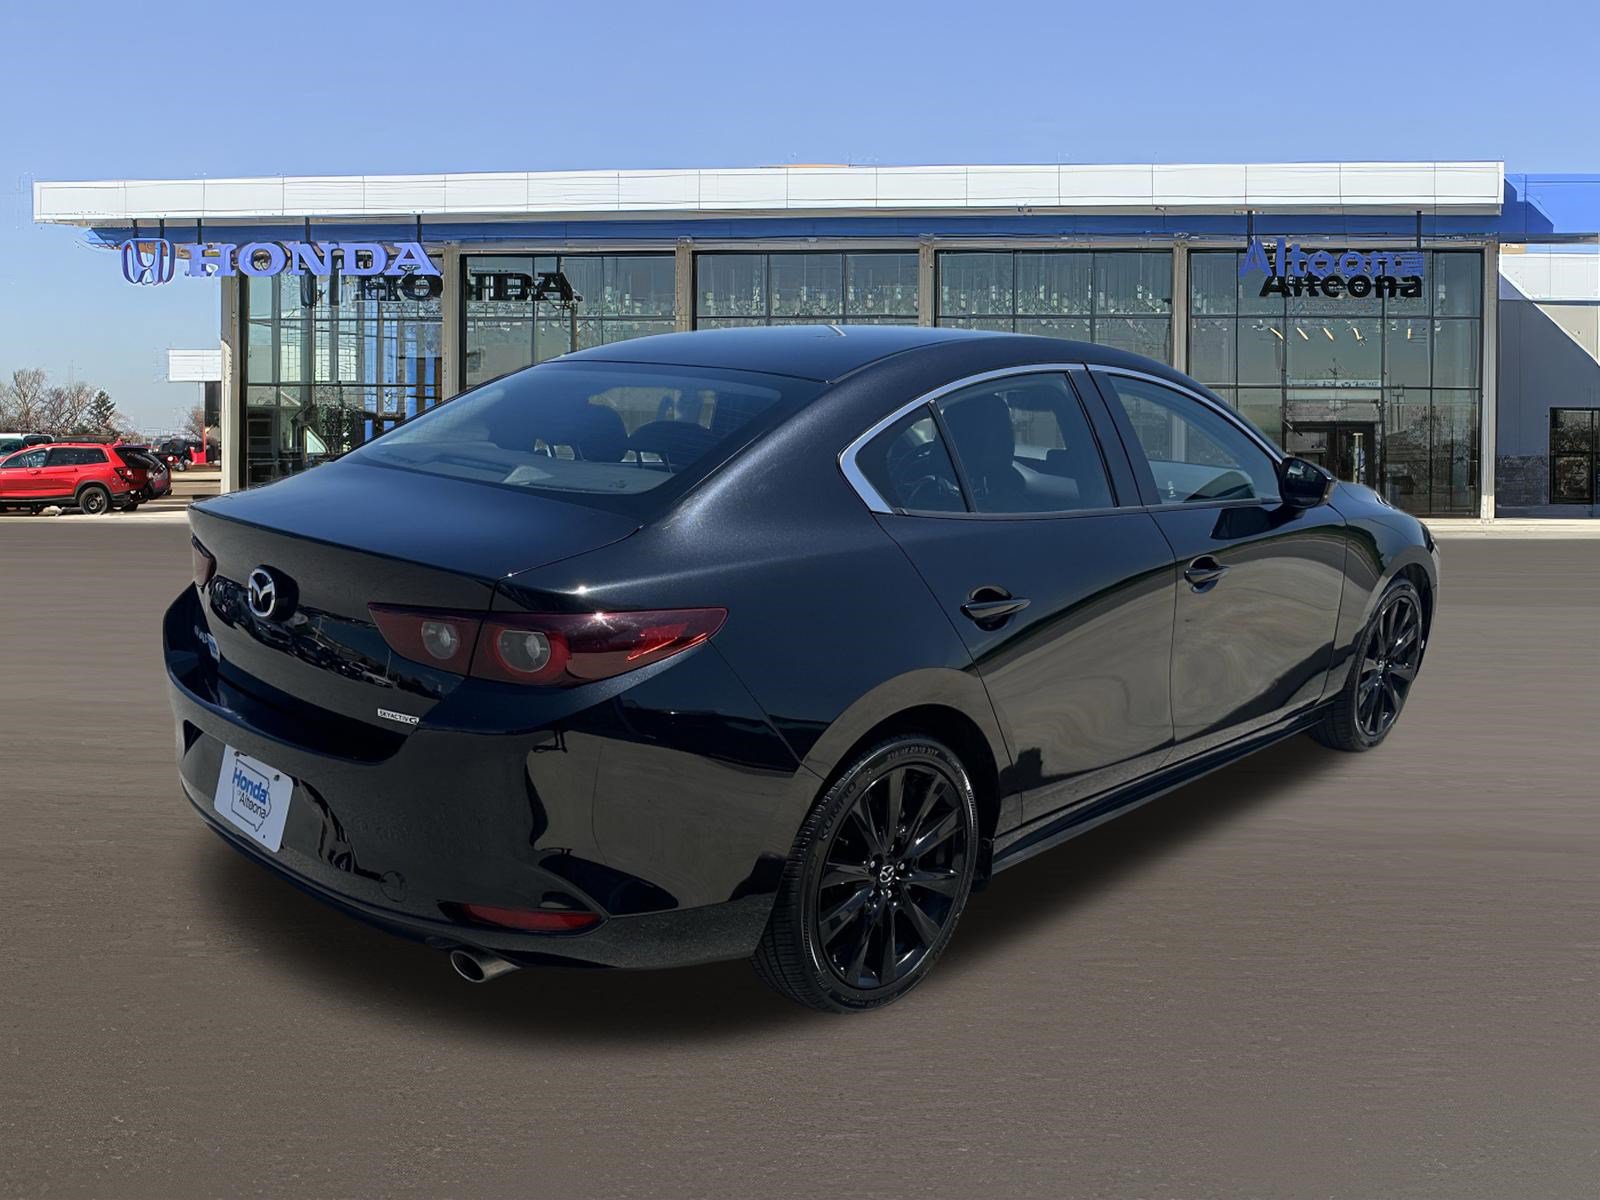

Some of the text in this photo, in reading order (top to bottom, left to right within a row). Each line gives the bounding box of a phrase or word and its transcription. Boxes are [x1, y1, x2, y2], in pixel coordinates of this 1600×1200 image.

[185, 241, 441, 278] HONDA
[232, 766, 268, 805] Honda
[239, 792, 267, 819] Altoona
